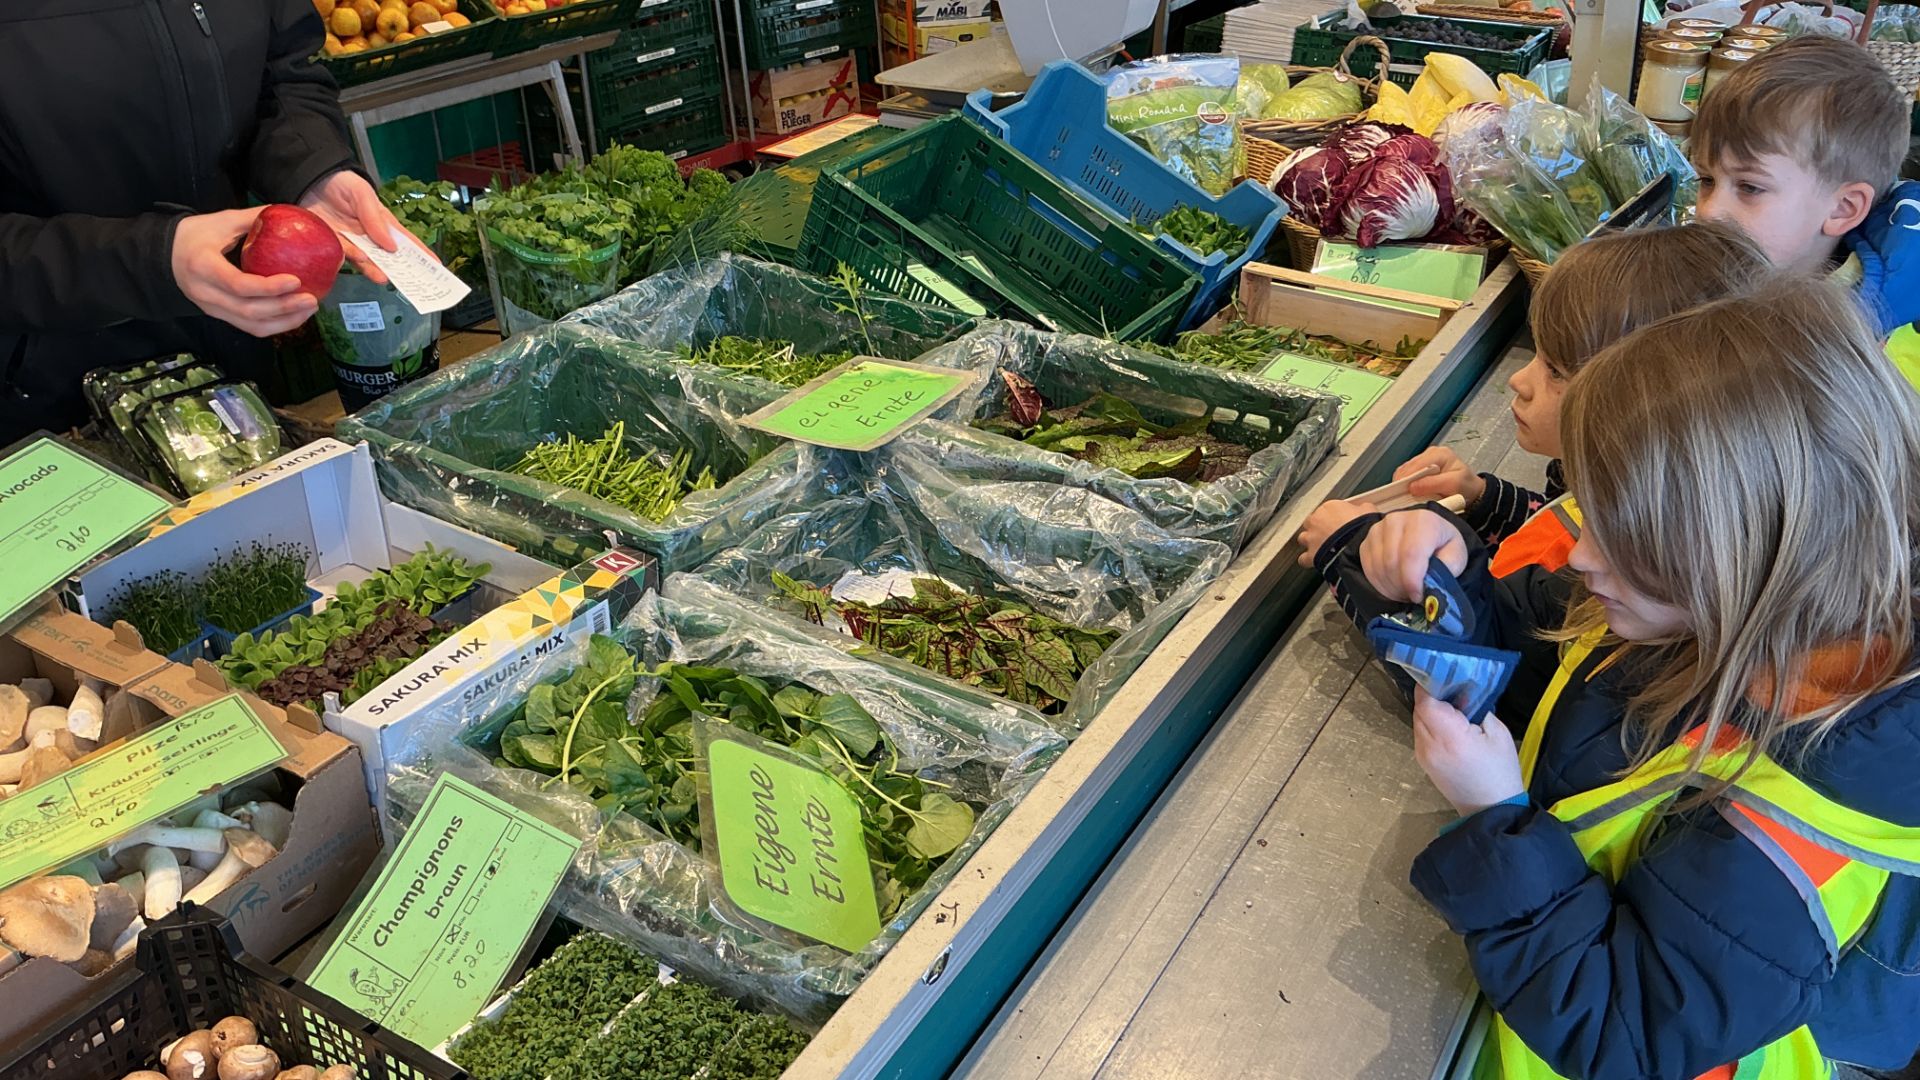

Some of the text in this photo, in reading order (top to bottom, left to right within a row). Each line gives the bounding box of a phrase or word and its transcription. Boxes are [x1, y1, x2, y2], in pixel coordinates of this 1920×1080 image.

[780, 109, 797, 121] DER
[782, 113, 812, 130] FLIEGER
[1138, 103, 1188, 120] Romana
[799, 378, 883, 429] eigene
[855, 389, 926, 429] Ernte
[0, 463, 59, 503] Avocado
[233, 442, 338, 488] SAKURA MIX
[602, 556, 632, 569] K
[535, 630, 566, 656] MIX
[368, 663, 450, 717] SAKURA
[448, 637, 488, 665] MIX
[88, 722, 239, 798] Kräuterseitlinge
[126, 732, 179, 763] Pilze
[90, 801, 139, 829] 2,60
[749, 762, 798, 897] Eigene
[800, 794, 846, 905] Ernte
[373, 814, 464, 948] Champignons
[424, 863, 468, 920] braun
[350, 907, 377, 942] Warenart:
[447, 930, 472, 965] Preis: EUR
[453, 938, 487, 990] 8,20
